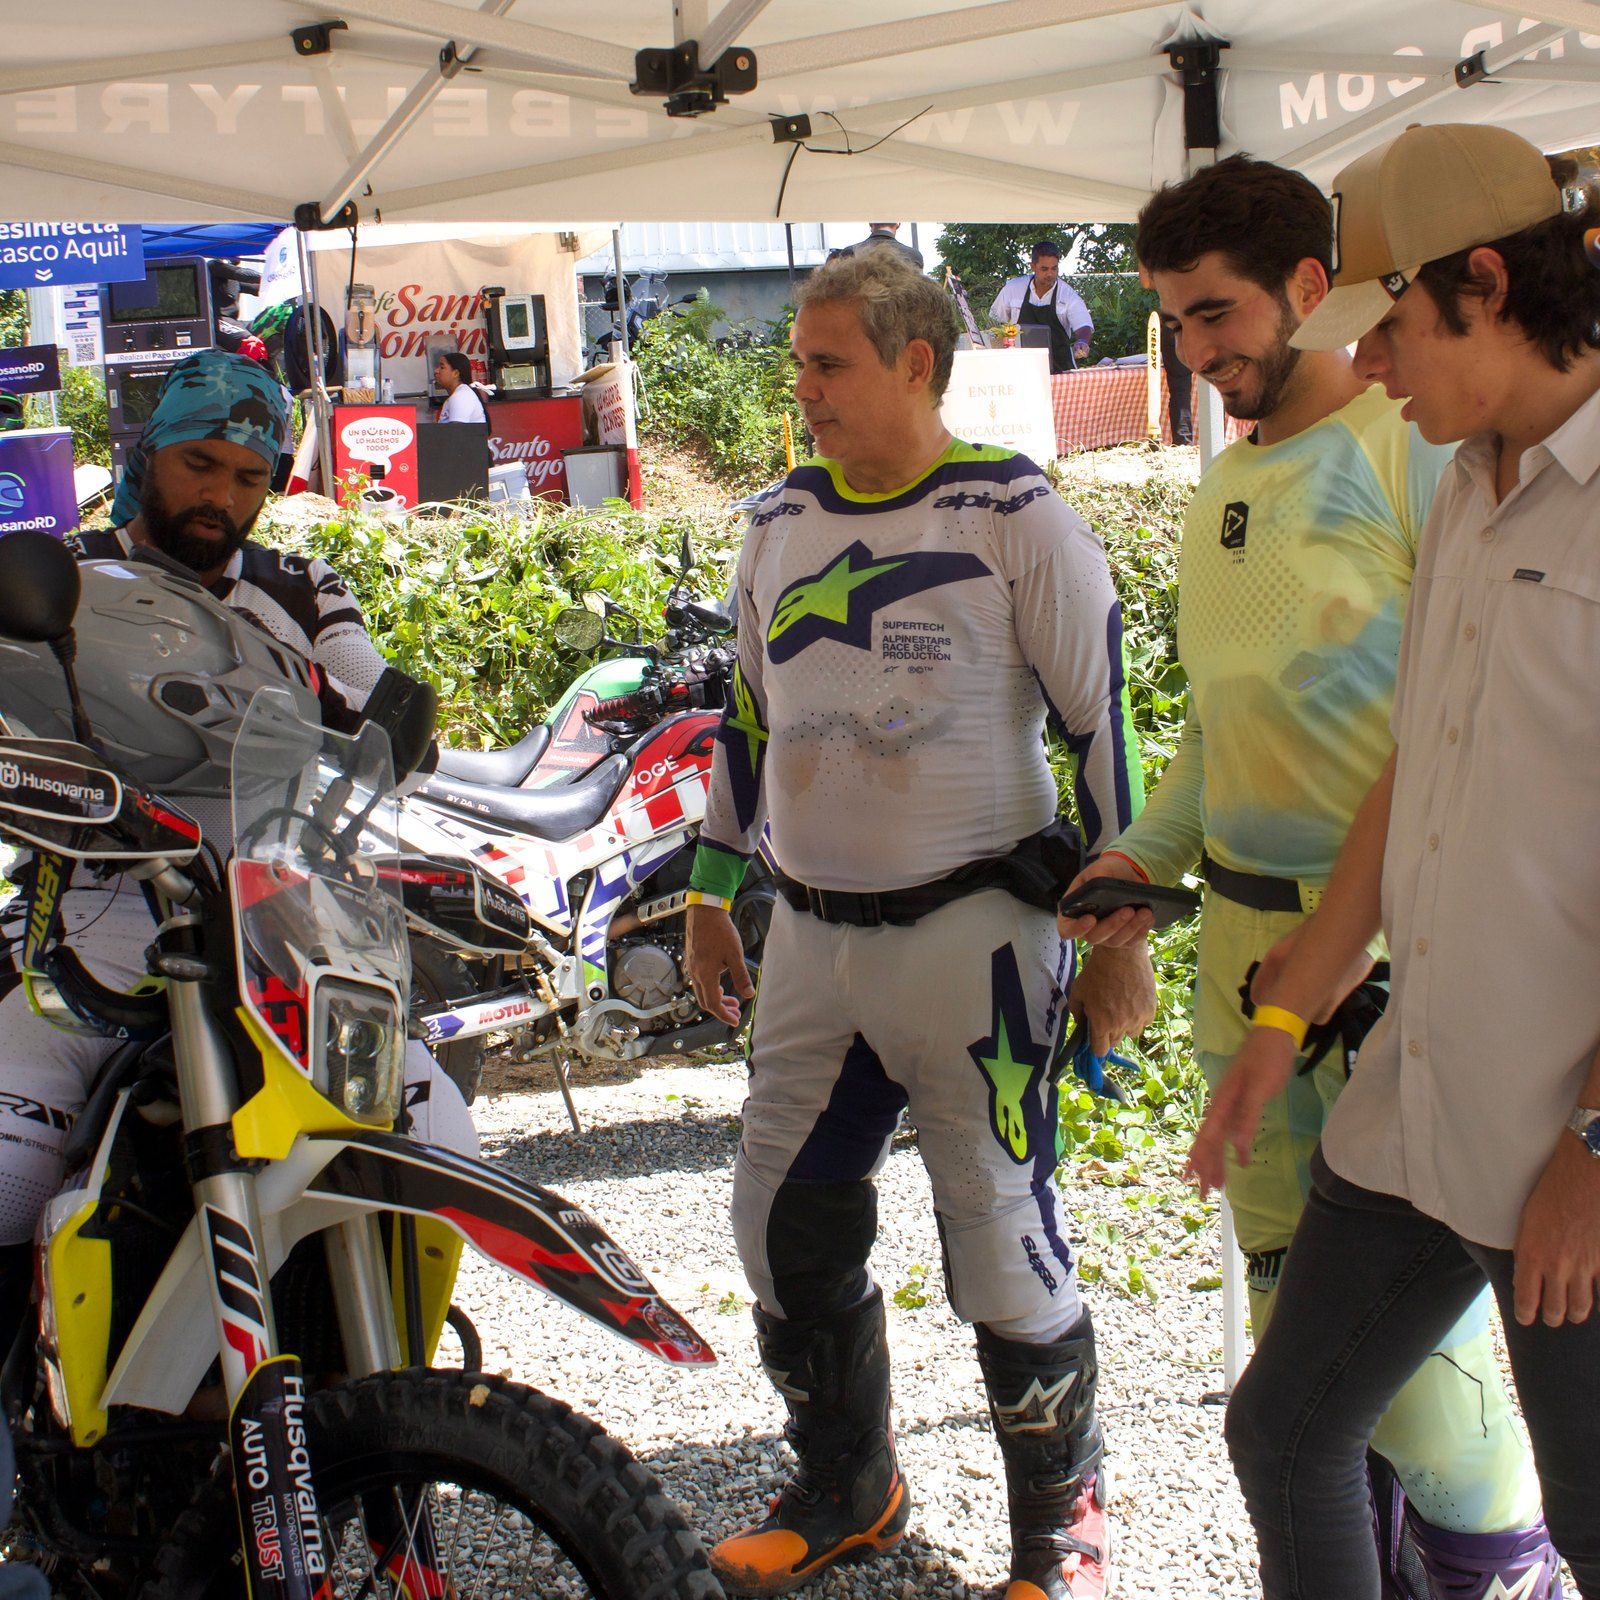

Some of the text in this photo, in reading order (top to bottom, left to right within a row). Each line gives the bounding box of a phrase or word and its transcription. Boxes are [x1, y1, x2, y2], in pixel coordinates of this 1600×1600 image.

[0, 234, 128, 265] asco Aqui!
[387, 284, 487, 328] Sant
[152, 351, 171, 361] Pago
[968, 384, 1016, 398] ENTRE
[954, 423, 1033, 438] FOCACCIAS
[488, 435, 550, 461] Santo
[882, 621, 945, 633] SUPERTECH
[882, 635, 952, 646] ALPINESTARS
[882, 644, 942, 654] RACE SPEC
[882, 651, 952, 662] PRODUCTION
[626, 755, 681, 790] VOGE
[22, 771, 105, 801] Husqvarna
[479, 1001, 532, 1025] MOTUL
[283, 1376, 325, 1575] Husqvarna
[240, 1418, 286, 1580] AUTO TRUST
[283, 1493, 304, 1576] MOTORCYCLES
